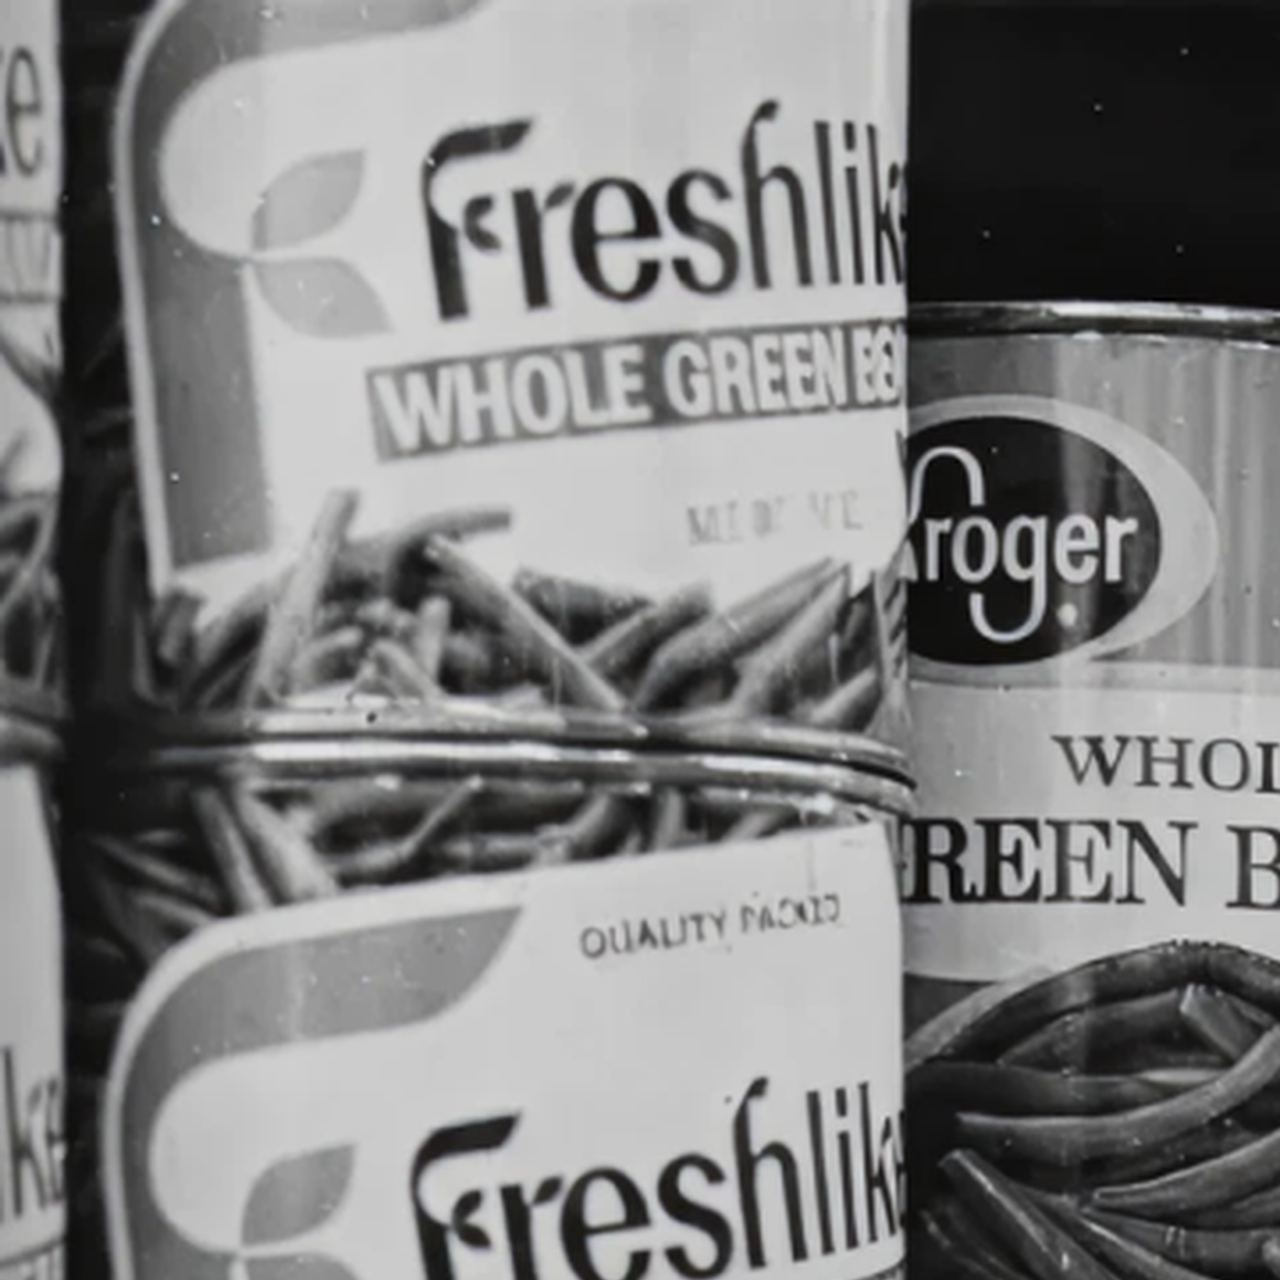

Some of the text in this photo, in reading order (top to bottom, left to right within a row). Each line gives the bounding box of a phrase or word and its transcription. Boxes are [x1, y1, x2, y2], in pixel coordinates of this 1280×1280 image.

[373, 341, 651, 455] WHOLE
[663, 326, 848, 417] GREEN
[902, 817, 1198, 906] REEN
[580, 908, 726, 959] QUALITY
